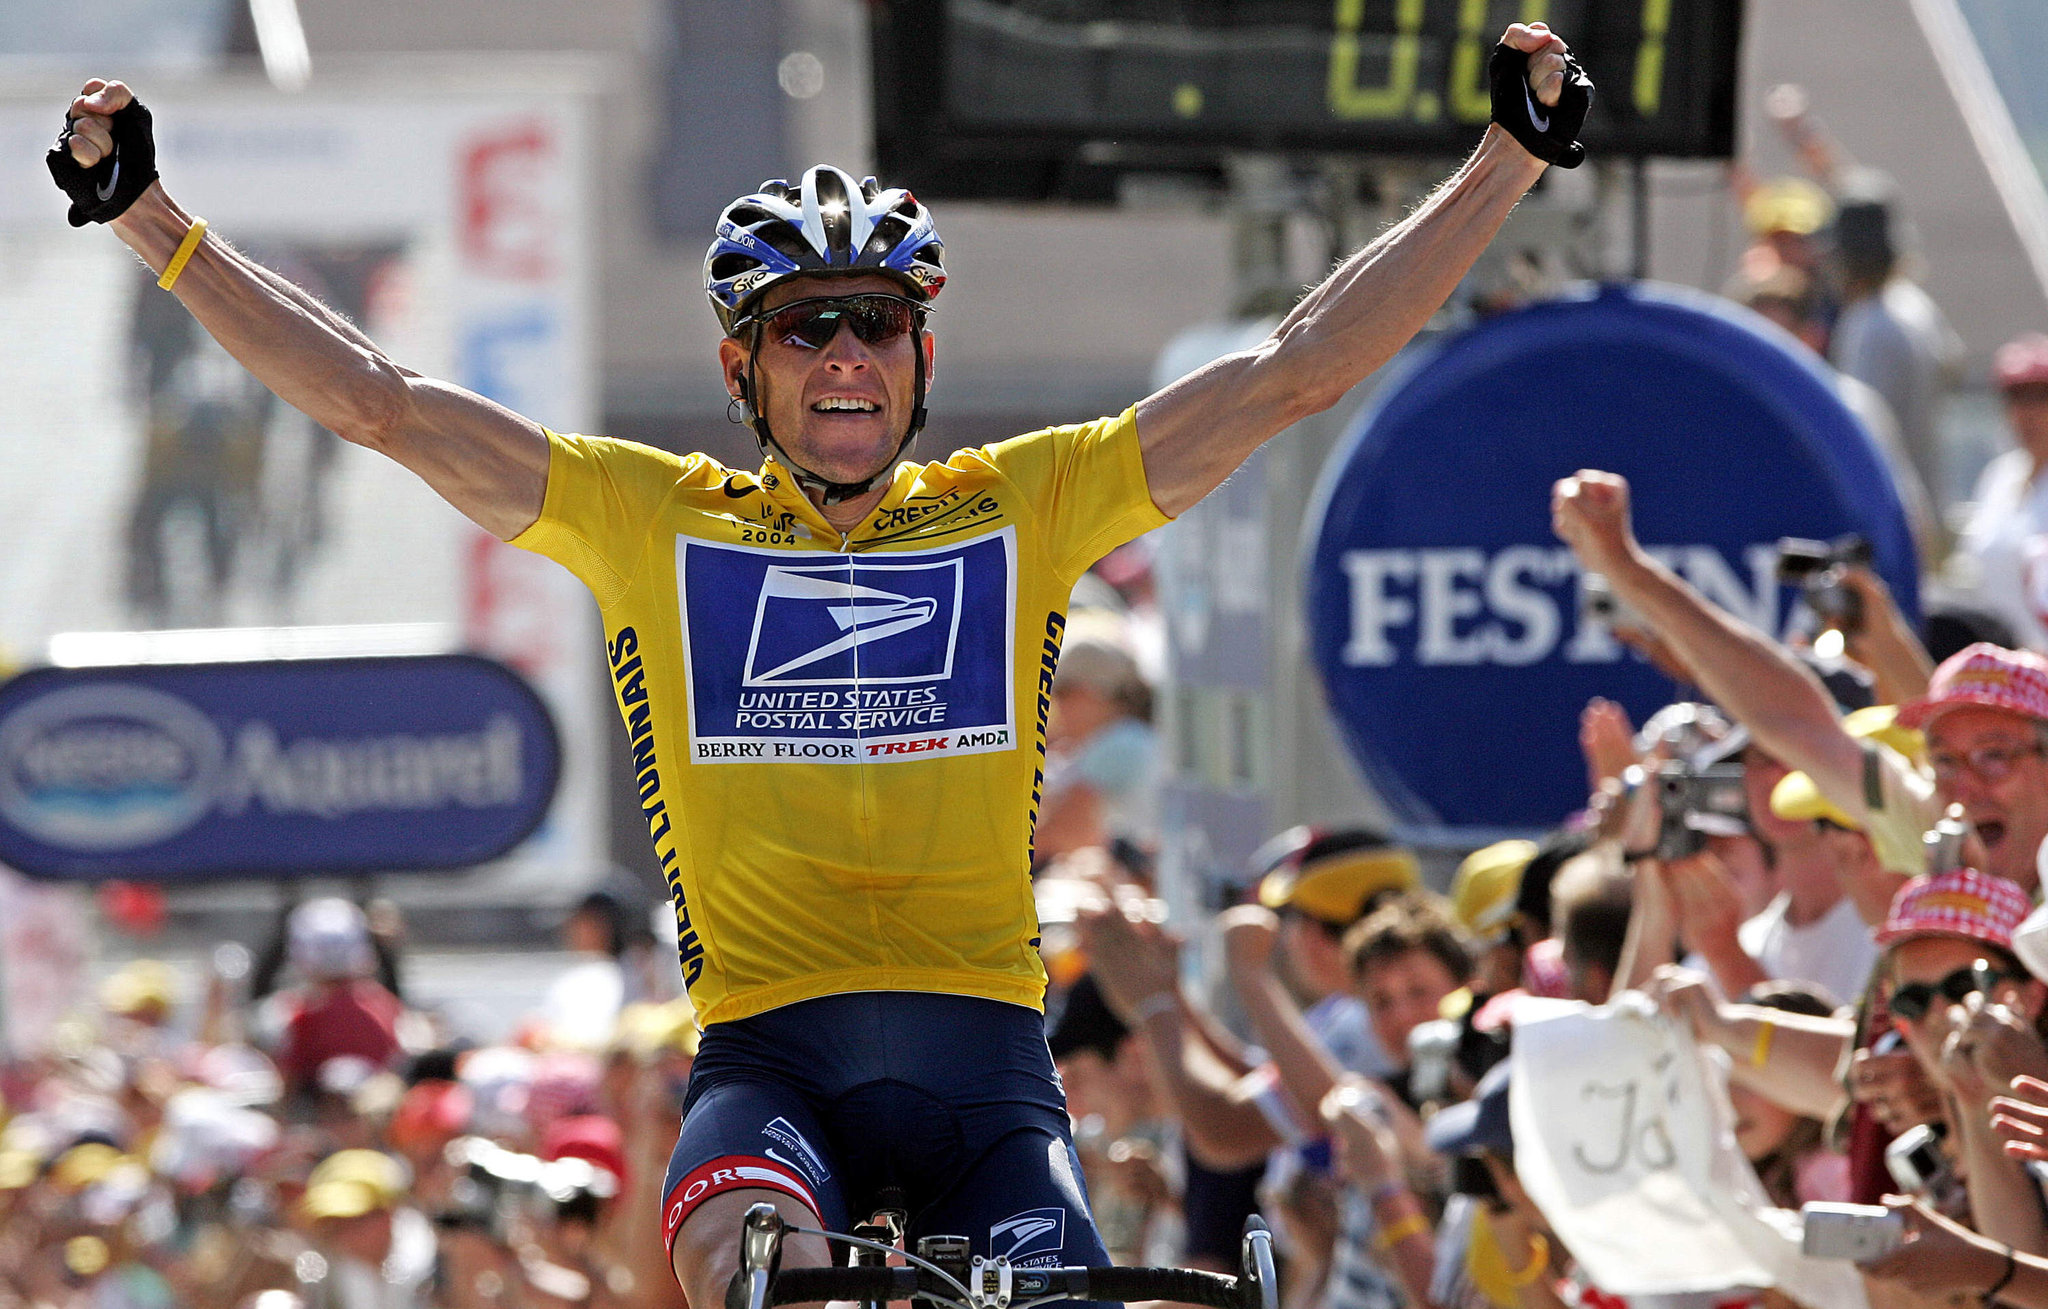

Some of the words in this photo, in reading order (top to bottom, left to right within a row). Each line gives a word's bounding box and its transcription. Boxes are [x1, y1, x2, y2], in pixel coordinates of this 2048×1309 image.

[731, 272, 767, 293] Giro
[909, 265, 937, 285] Giro
[761, 501, 774, 519] Le
[873, 489, 961, 531] CREDIT
[741, 529, 796, 546] 2004
[1340, 545, 1822, 668] FESTN
[738, 691, 840, 709] UNITED
[843, 685, 939, 708] STATES
[735, 711, 834, 730] POSTAL
[836, 705, 948, 730] SERVICE
[697, 741, 765, 758] BERRY
[773, 742, 857, 759] FLOOR
[865, 736, 950, 757] TREK
[956, 732, 996, 748] AMD
[1023, 1254, 1059, 1269] STATES
